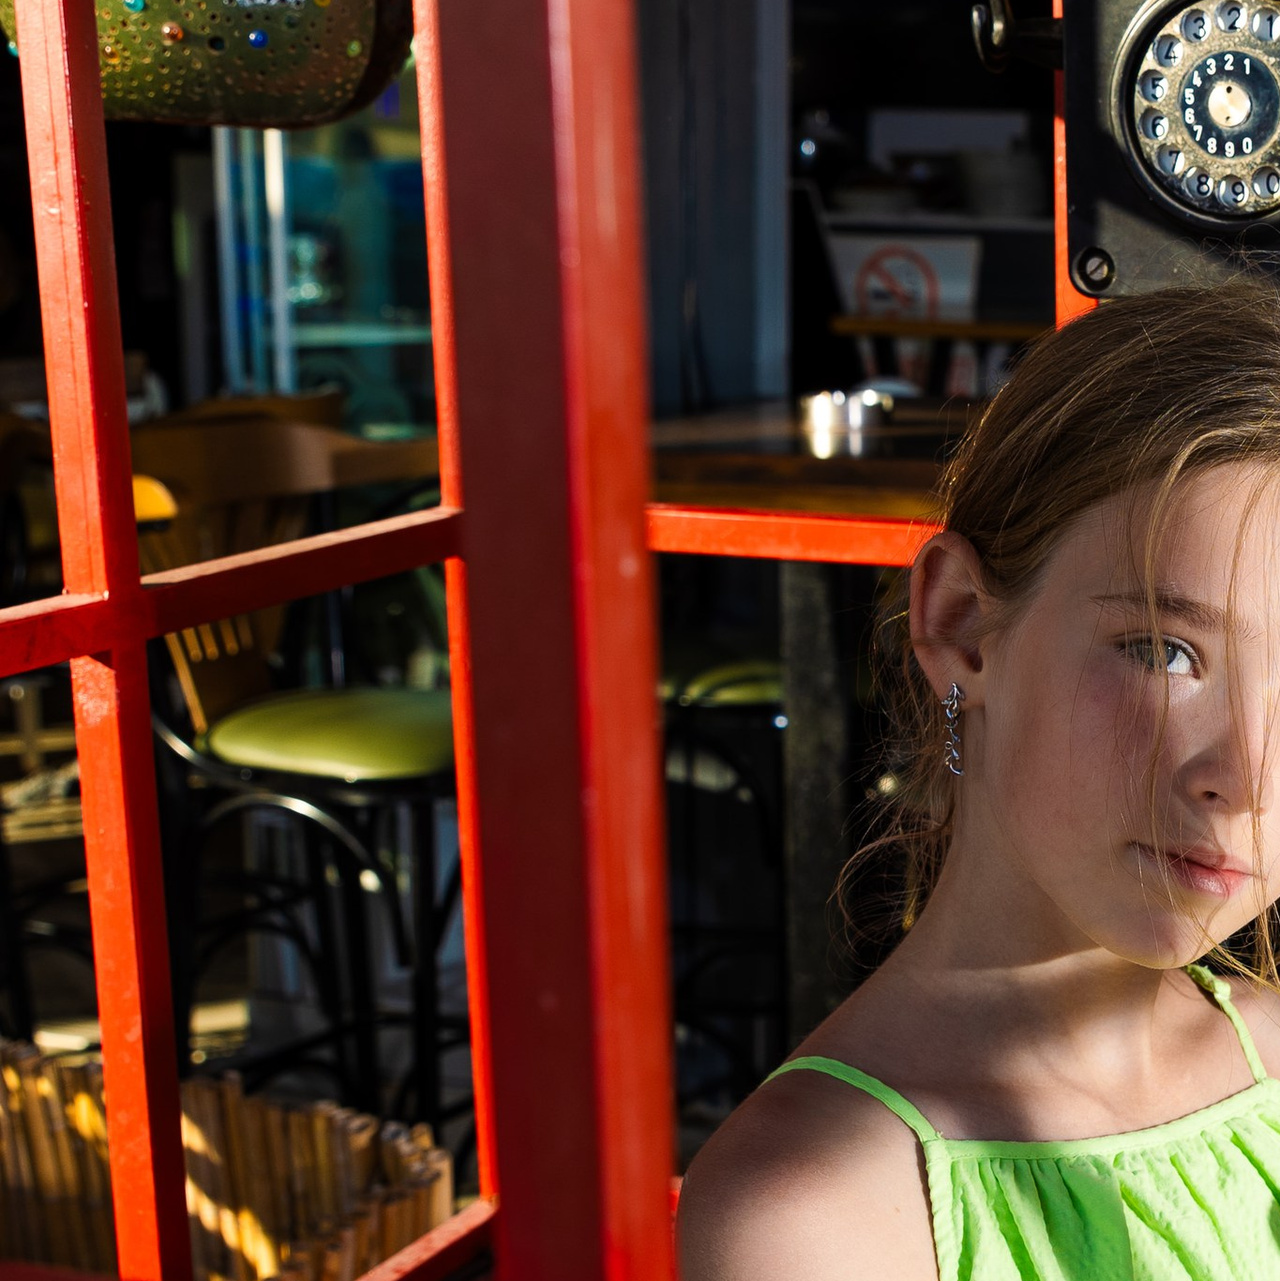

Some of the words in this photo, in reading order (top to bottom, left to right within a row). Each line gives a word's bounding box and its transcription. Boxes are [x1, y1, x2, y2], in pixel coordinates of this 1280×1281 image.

[1227, 7, 1240, 30] 2
[1267, 14, 1274, 38] 1
[1193, 17, 1206, 39] 3
[1164, 42, 1178, 63] 4
[1206, 58, 1216, 75] 3
[1224, 54, 1234, 70] 2
[1244, 58, 1250, 74] 1
[1193, 70, 1202, 87] 4
[1151, 78, 1164, 100] 5
[1185, 88, 1194, 105] 5
[1185, 108, 1194, 124] 6
[1152, 117, 1165, 138] 6
[1193, 125, 1202, 141] 7
[1207, 137, 1217, 154] 8
[1225, 141, 1235, 157] 9
[1242, 137, 1252, 153] 0
[1169, 150, 1182, 170] 7
[1197, 174, 1209, 196] 8
[1231, 181, 1244, 203] 9
[1267, 173, 1280, 195] 0
